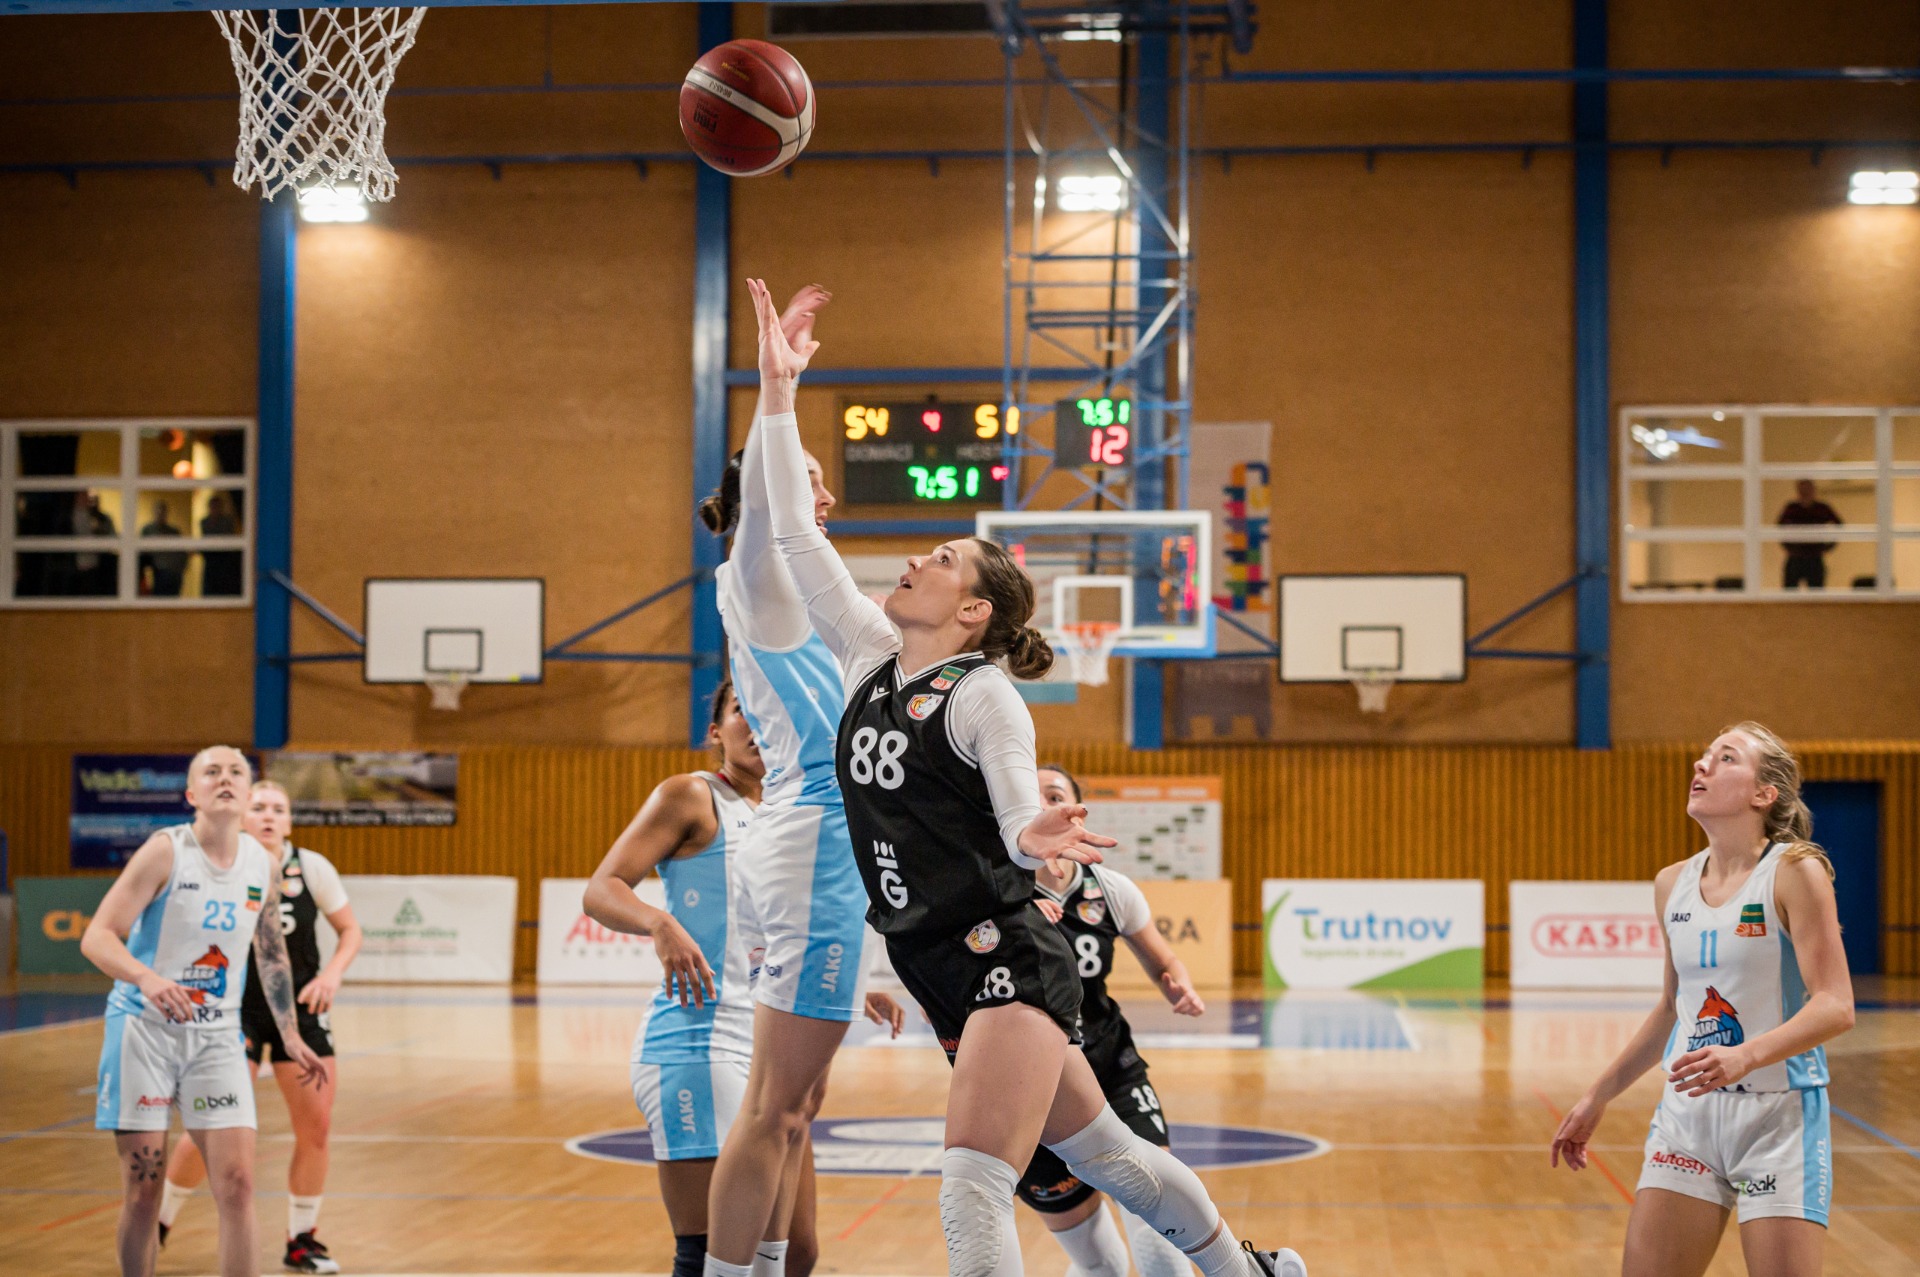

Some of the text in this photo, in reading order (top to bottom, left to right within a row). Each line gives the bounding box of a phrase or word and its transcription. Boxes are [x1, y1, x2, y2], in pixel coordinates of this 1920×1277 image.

[845, 405, 889, 440] 54
[975, 403, 1020, 439] 51
[1090, 425, 1129, 465] 12
[908, 465, 980, 499] 7:51
[850, 726, 909, 790] 88
[178, 882, 199, 891] JAKO
[202, 900, 236, 932] 23
[1155, 917, 1201, 942] RA
[1292, 908, 1452, 941] Trutnov
[1670, 912, 1691, 923] JAKO
[1547, 924, 1664, 948] KASPE
[1700, 930, 1718, 968] 11
[821, 942, 844, 994] JAKO
[678, 1089, 697, 1134] JAKO
[1130, 1083, 1161, 1114] 18
[1650, 1151, 1712, 1175] Autosty
[1816, 1138, 1832, 1207] Trutnov
